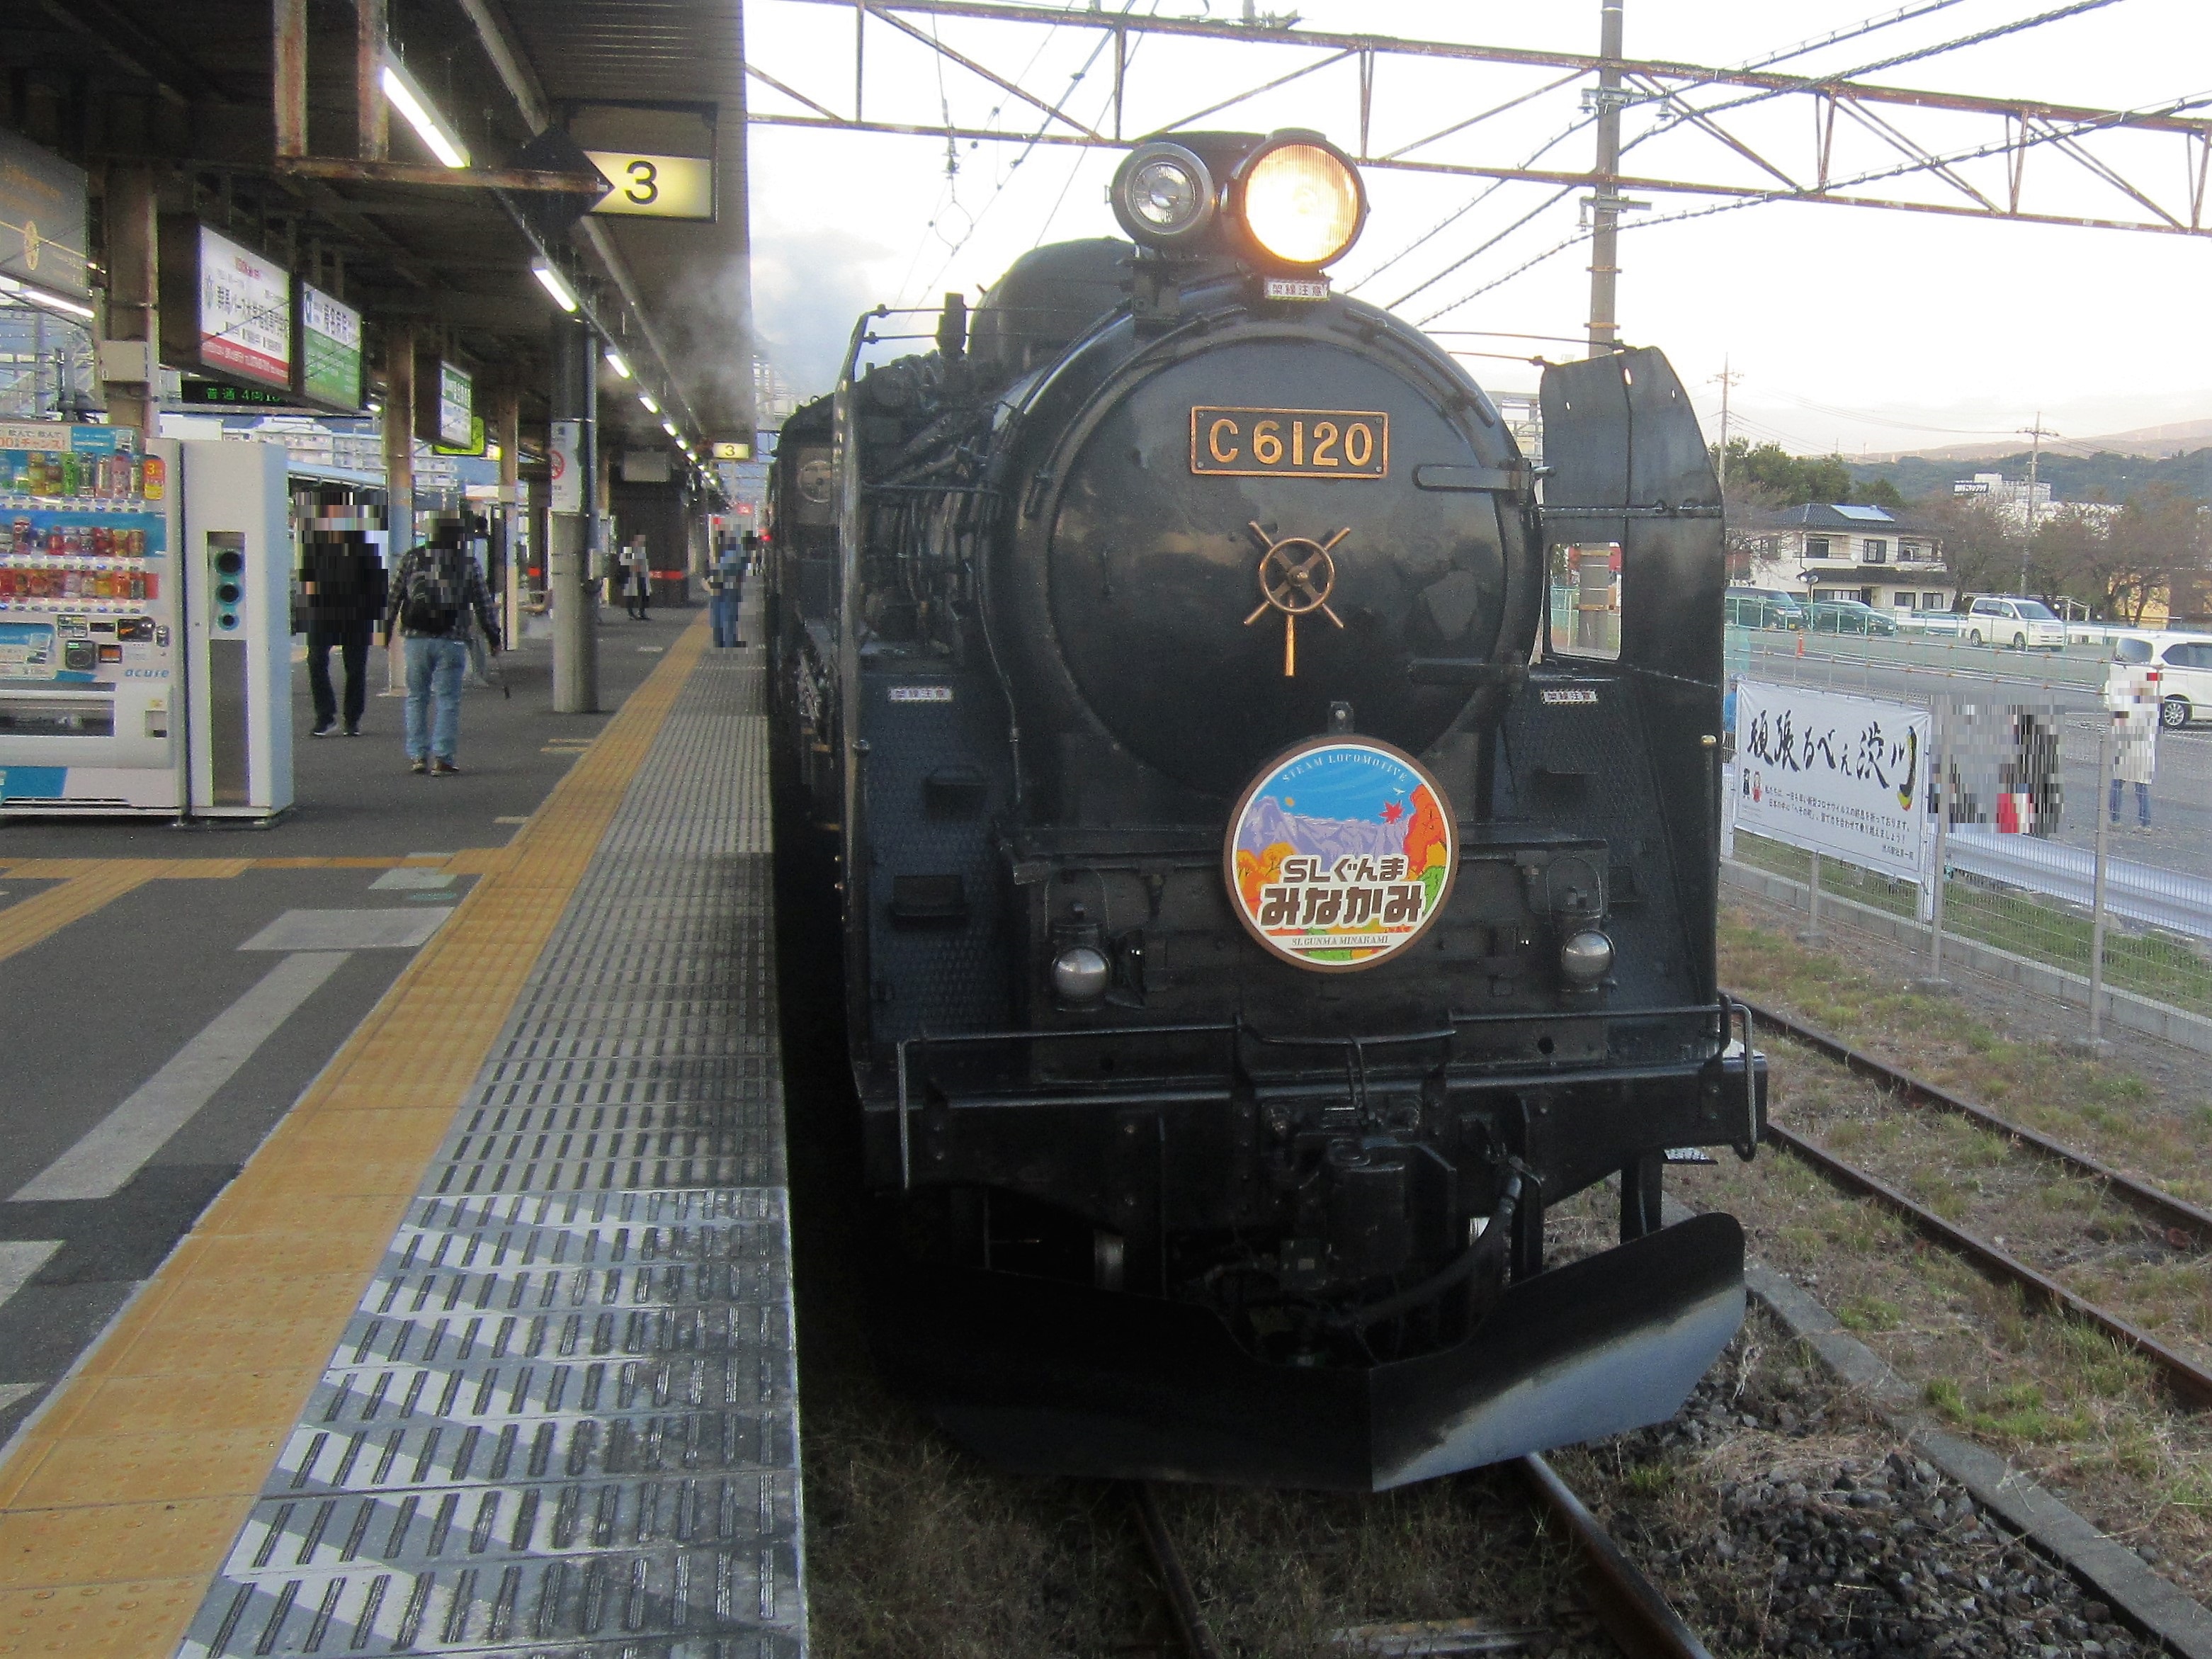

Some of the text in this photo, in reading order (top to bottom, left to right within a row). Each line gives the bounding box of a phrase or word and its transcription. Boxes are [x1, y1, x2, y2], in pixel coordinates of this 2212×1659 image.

[624, 160, 659, 205] 3
[725, 445, 736, 456] 3
[1282, 754, 1408, 782] STEAM LOCOMOTIVE
[1283, 856, 1407, 883] SLぐんま
[1260, 885, 1424, 927] みなかみ
[1339, 936, 1389, 945] MINAKAMI
